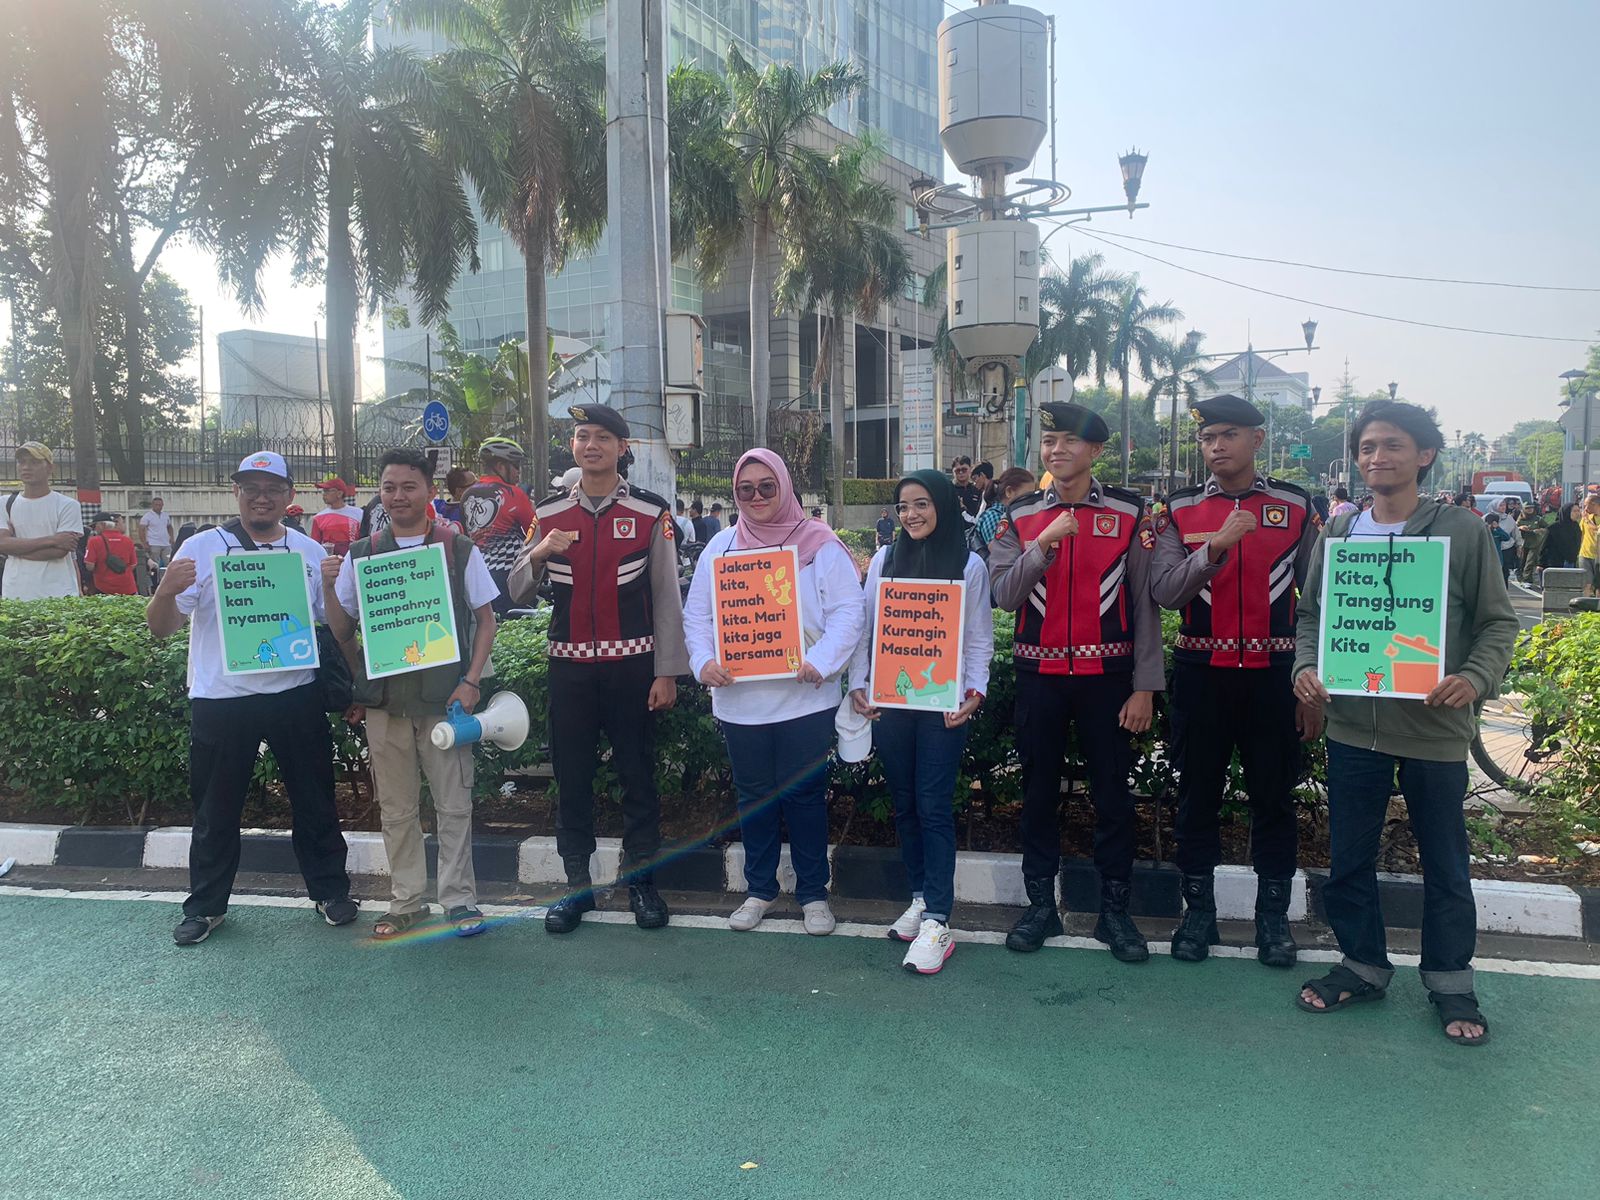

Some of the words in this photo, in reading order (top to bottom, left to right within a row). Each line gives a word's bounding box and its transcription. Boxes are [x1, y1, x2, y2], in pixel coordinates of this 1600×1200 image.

[1337, 549, 1415, 567] Sampah
[221, 560, 265, 572] Kalau
[363, 558, 416, 575] Ganteng
[720, 559, 771, 574] Jakarta
[223, 577, 275, 589] bersih,
[365, 575, 407, 589] doang,
[410, 567, 435, 581] tapi
[720, 578, 749, 591] kita,
[1334, 571, 1378, 588] Kita,
[225, 595, 253, 607] kan
[367, 589, 406, 603] buang
[721, 595, 765, 608] rumah
[885, 588, 949, 604] Kurangin
[1334, 593, 1434, 612] Tanggung
[369, 597, 440, 618] sampahnya
[884, 606, 944, 622] Sampah,
[228, 613, 289, 627] nyaman
[370, 611, 441, 632] sembarang
[722, 612, 751, 626] kita.
[755, 609, 786, 622] Mari
[1332, 616, 1396, 631] Jawab
[723, 632, 749, 643] kita
[751, 629, 781, 644] jaga
[882, 624, 946, 641] Kurangin
[881, 642, 942, 657] Masalah
[1331, 638, 1369, 653] Kita
[725, 646, 783, 661] bersama
